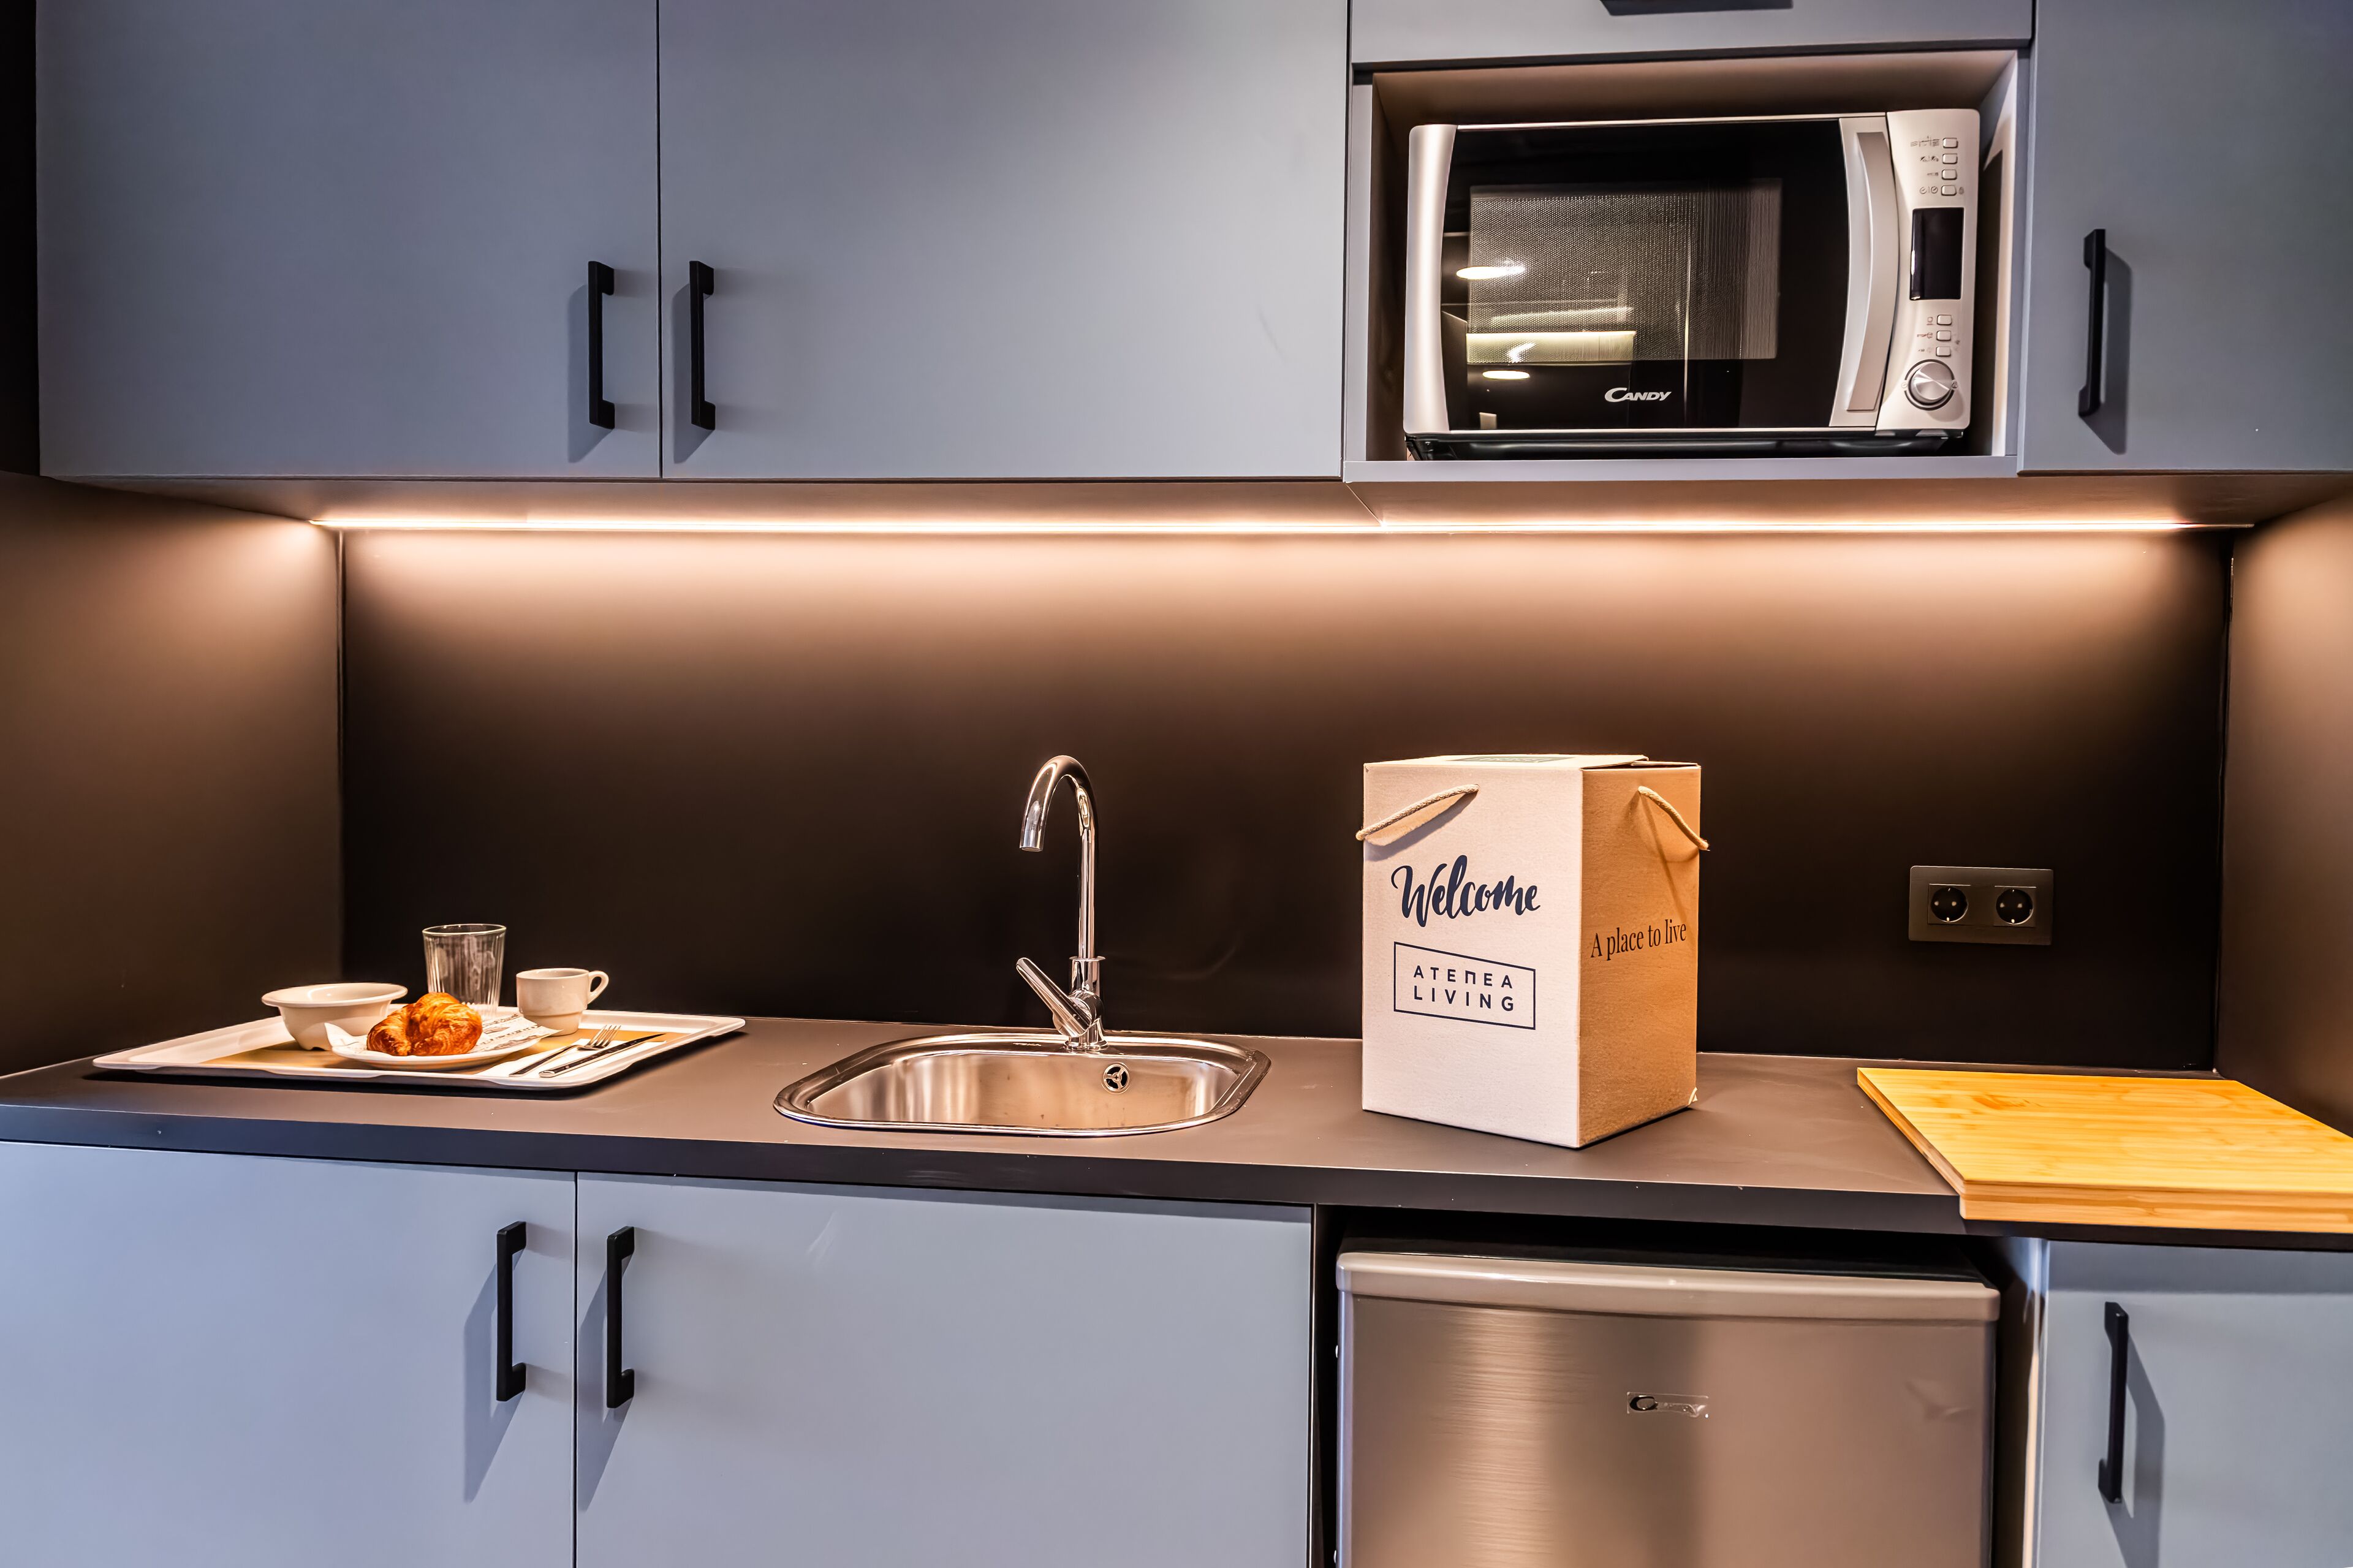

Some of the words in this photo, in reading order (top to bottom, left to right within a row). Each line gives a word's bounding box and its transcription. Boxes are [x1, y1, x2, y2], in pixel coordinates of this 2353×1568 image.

[1604, 387, 1672, 403] CANDY
[1390, 855, 1541, 928] Welcome
[1590, 932, 1604, 959] A
[1605, 926, 1644, 961] place
[1648, 925, 1661, 947] to
[1664, 918, 1687, 945] live
[1413, 985, 1514, 1012] LIVING
